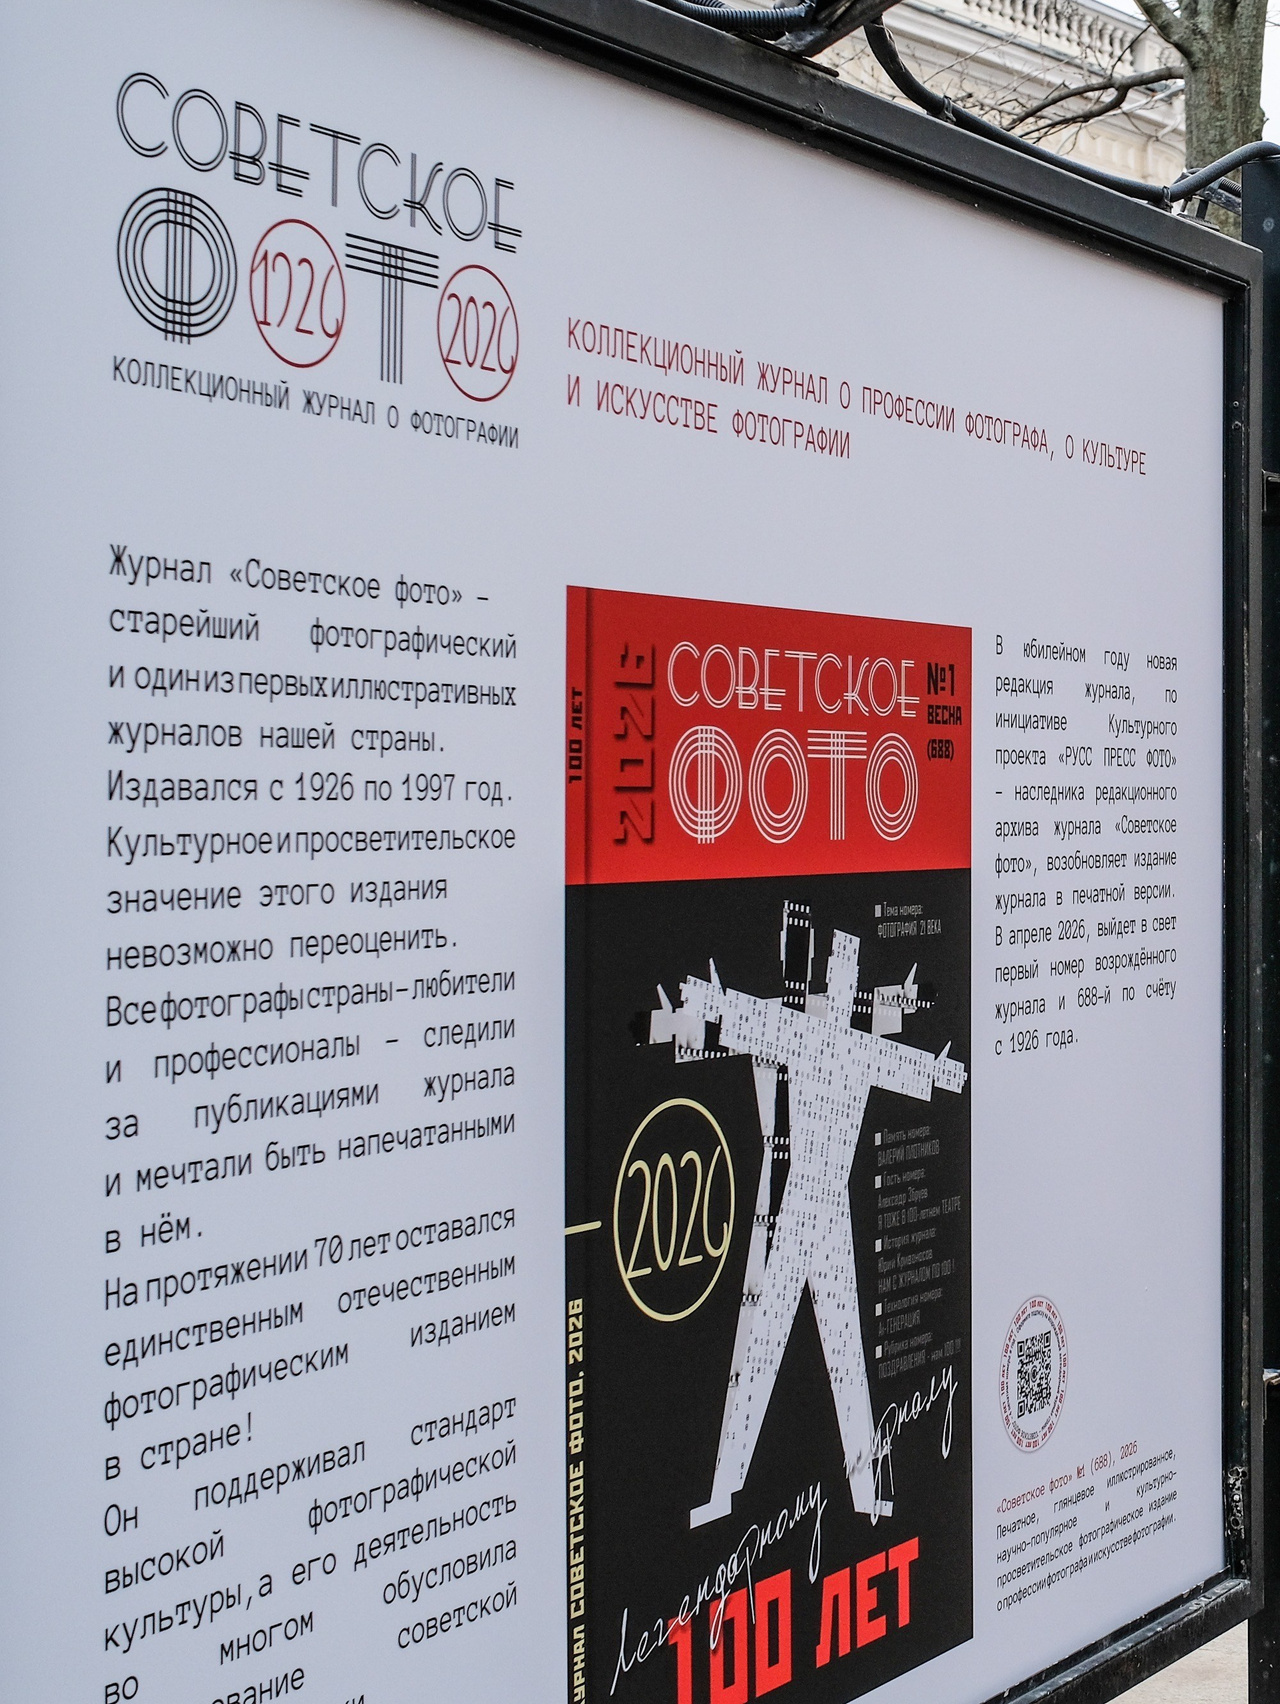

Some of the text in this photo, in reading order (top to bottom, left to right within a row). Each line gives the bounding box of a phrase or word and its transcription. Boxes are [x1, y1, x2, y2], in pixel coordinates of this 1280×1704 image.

[116, 72, 522, 254] СОВЕТСКОЕ
[112, 355, 519, 450] КОЛЛЕКЦИОННЫЙ ЖУРНАЛ О ФОТОГРАФИИ
[567, 316, 1147, 476] КОЛЛЕКЦИОННЫЙ ЖУРНАЛ О ПРОФЕССИИ ФОТОГРАФА, О КУЛЬТУРЕ
[567, 373, 850, 460] И ИСКУССТВЕ ФОТОГРАФИИ
[108, 543, 463, 610] Журнал «Советское фото»
[108, 608, 517, 661] старейший фотографический
[995, 634, 1178, 672] В юбилейном году новая
[667, 641, 920, 717] СОВЕТСКОЕ
[926, 662, 955, 696] №1
[995, 675, 1178, 706] редакция журнала, по
[567, 686, 583, 784] 100 ЛЕТ
[926, 704, 962, 726] ВЕСНА
[926, 738, 954, 762] (688)
[995, 745, 1177, 770] проекта «РУСС ПРЕСС ФОТО»
[107, 769, 512, 809] Издавался с 1926 по 1997 год.
[668, 725, 919, 844] ФОТО
[107, 825, 516, 867] Культурное и просветительское
[877, 921, 918, 938] ФОТОГРАФИЯ
[927, 919, 942, 935] ВЕКА
[883, 901, 899, 917] Тема
[995, 915, 1177, 950] В апреле 2026, выйдет в свет
[105, 968, 516, 1031] Все фотографы страны любители
[994, 977, 1177, 1025] журнала и 688-й по счёту
[104, 1207, 516, 1311] На протяжении 70 лет оставался
[103, 1396, 517, 1537] Он поддерживал стандарт
[104, 1411, 252, 1482] в стране!
[996, 1484, 1046, 1514] «Советское
[1048, 1474, 1073, 1495] фото»
[1090, 1450, 1116, 1476] (688),
[1119, 1439, 1138, 1460] 2026
[568, 1298, 585, 1704] УРНАЛ СОВЕТСКОЕ ФОТО, 2026
[996, 1448, 1176, 1541] Печатное, глянцевое иллюстрированное,
[668, 1536, 919, 1704] 100 ЛЕТ
